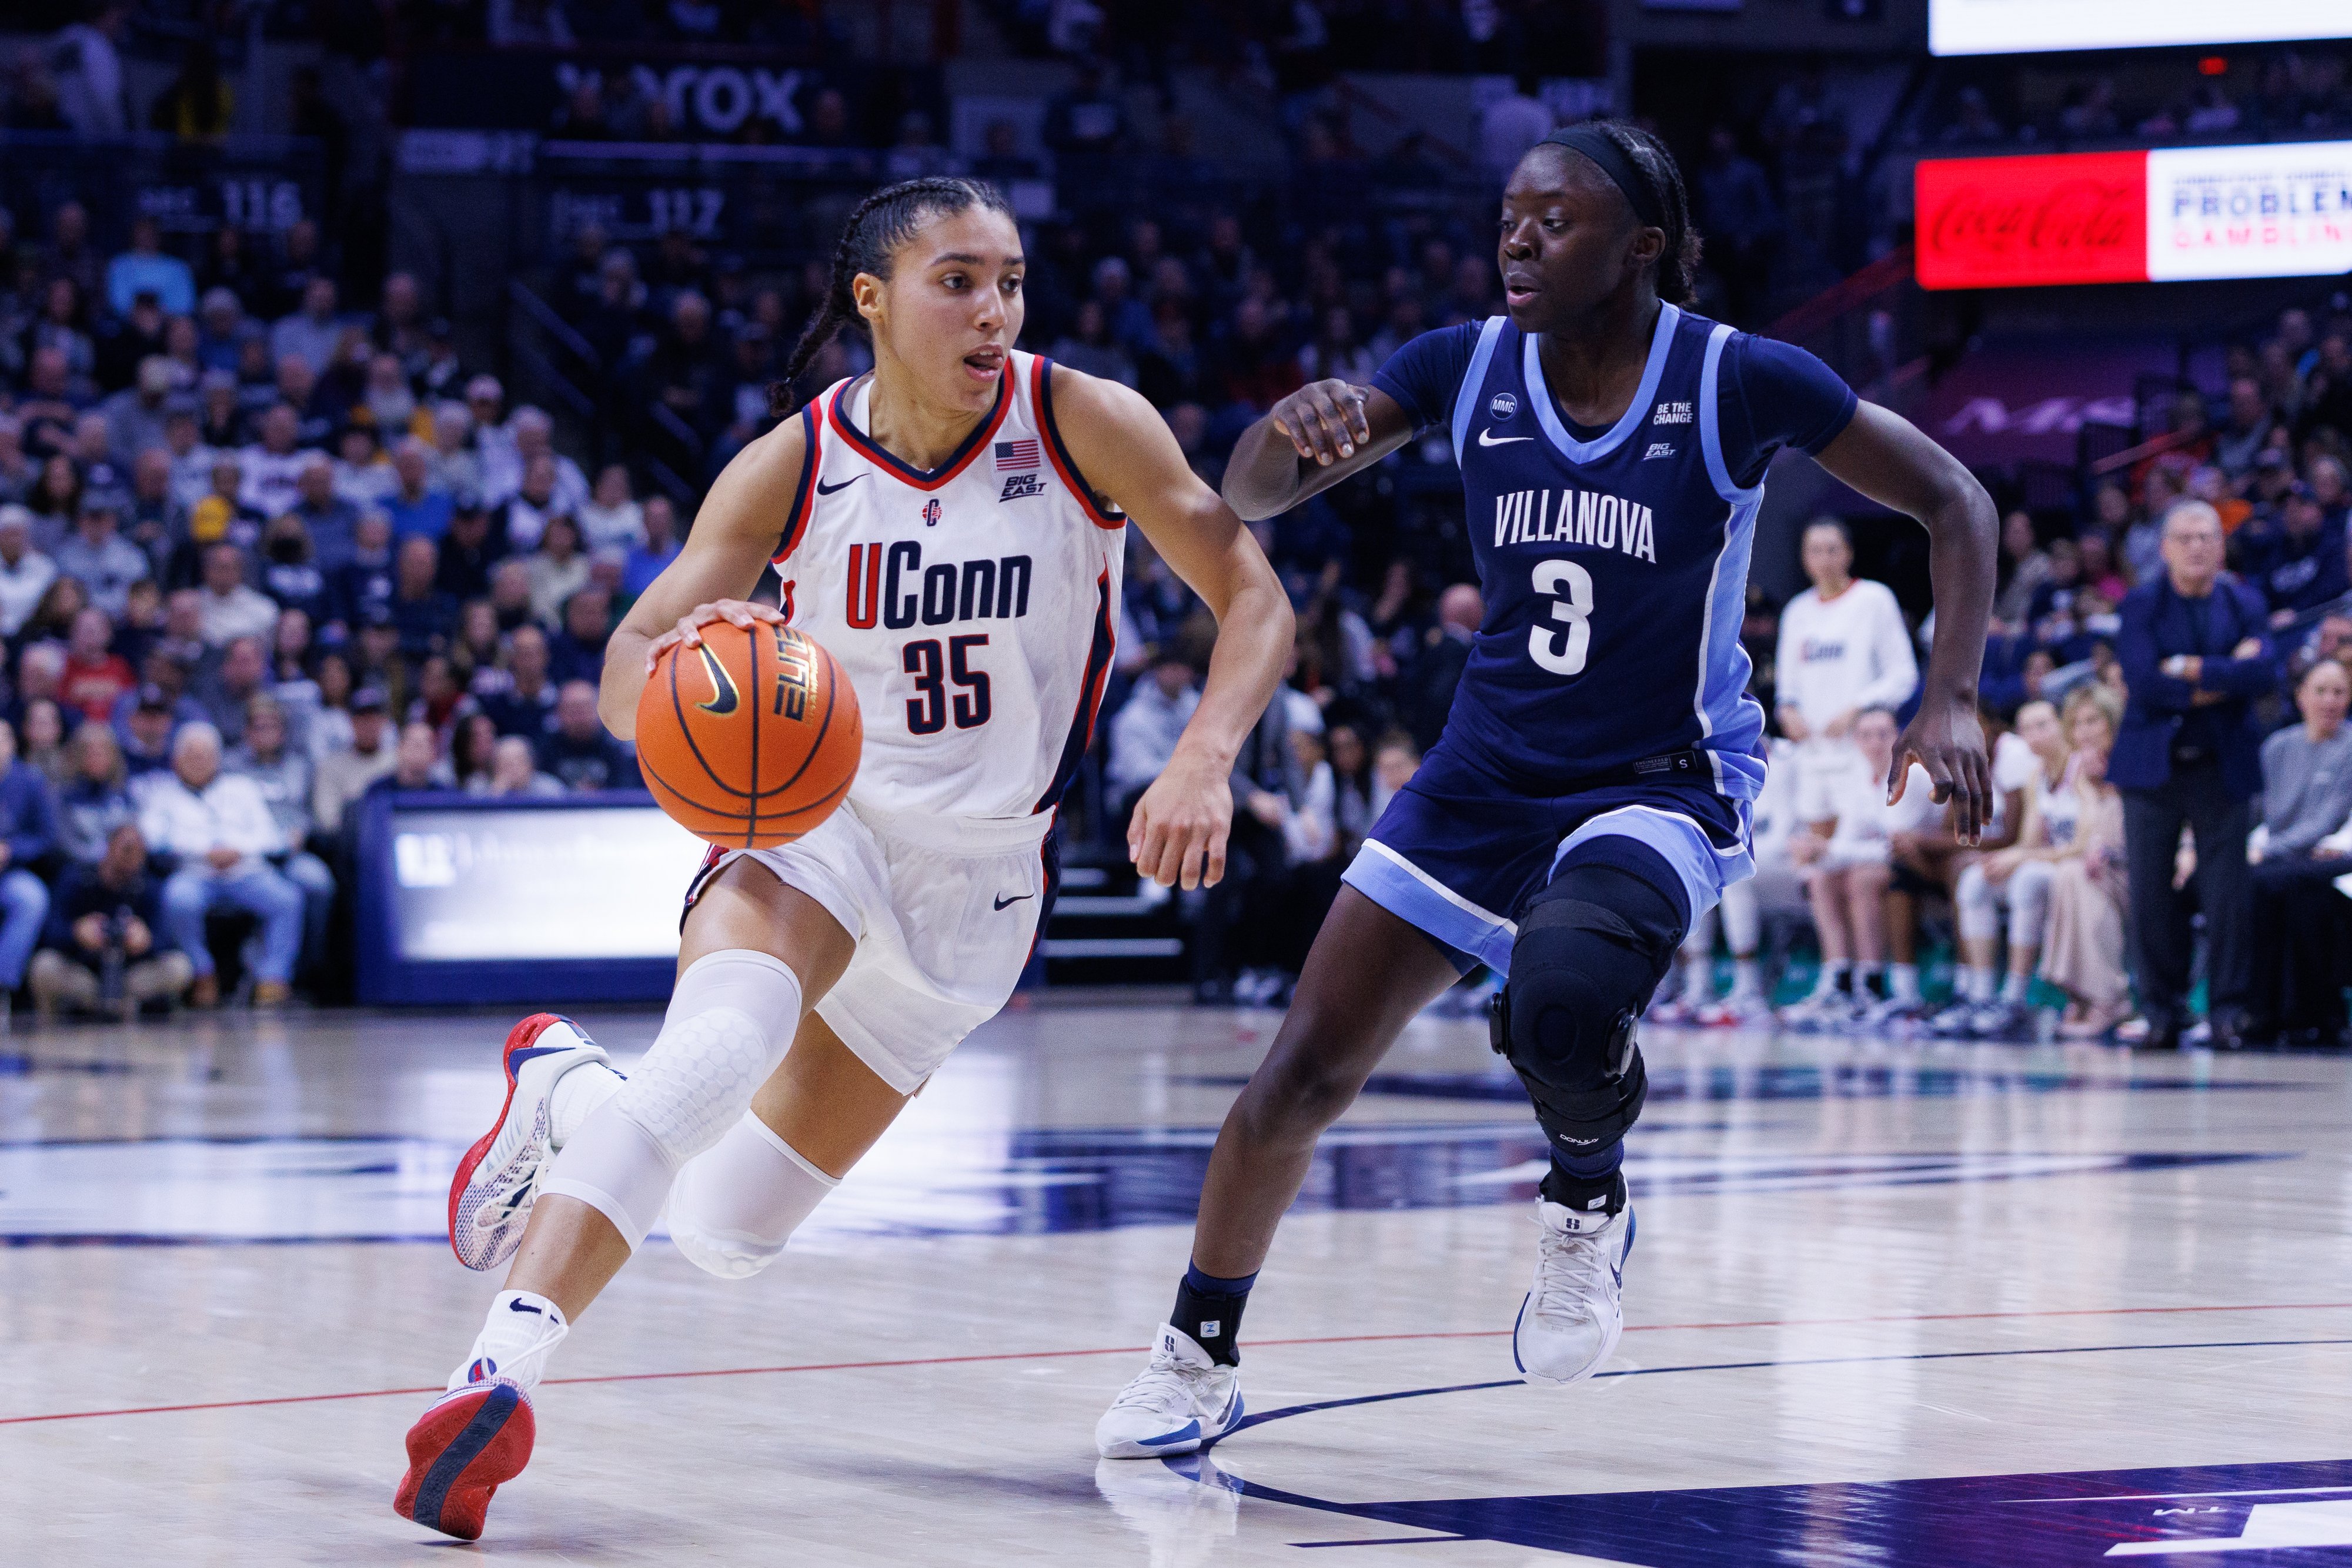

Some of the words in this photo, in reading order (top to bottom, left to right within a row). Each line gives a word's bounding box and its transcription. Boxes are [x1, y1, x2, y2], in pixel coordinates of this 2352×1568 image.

[1492, 399, 1515, 413] MMG
[1657, 403, 1669, 414] BE
[1672, 402, 1692, 413] THE
[1653, 413, 1693, 425] CHANGE
[1005, 473, 1038, 487] BIG
[1001, 482, 1047, 497] EAST
[1494, 489, 1657, 564] VILLANOVA
[846, 540, 1033, 630] UConn
[1528, 559, 1594, 676] 3
[773, 624, 810, 722] ELITE
[902, 633, 991, 736] 35
[1678, 758, 1688, 769] S
[1559, 1134, 1599, 1145] DONJOY
